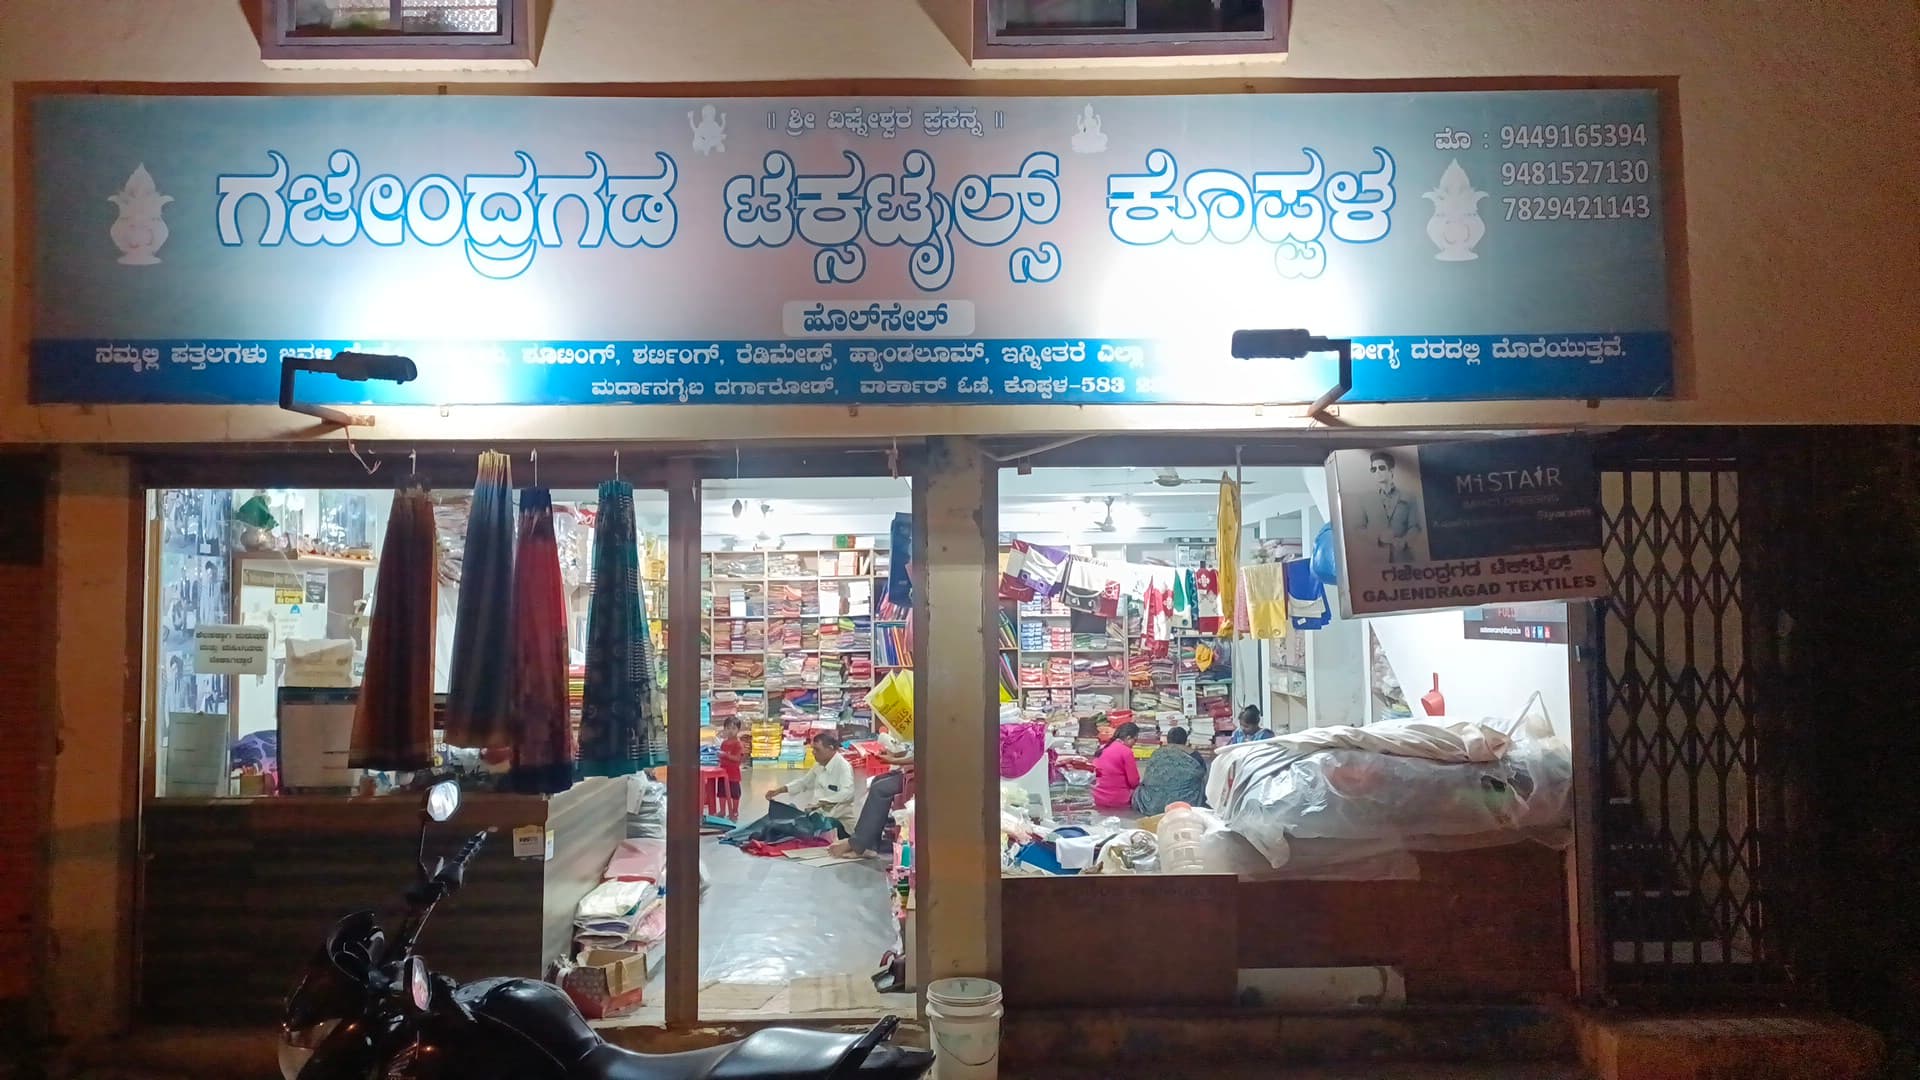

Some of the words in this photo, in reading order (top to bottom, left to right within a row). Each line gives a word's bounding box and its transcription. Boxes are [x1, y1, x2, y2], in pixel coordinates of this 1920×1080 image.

[786, 108, 816, 136] ಶ್ರೀ
[923, 106, 985, 137] ಪ್ರಸನ್ನ
[1500, 123, 1648, 150] 9449165394
[1501, 159, 1650, 186] 9481527130
[216, 149, 678, 280] ಗಜೇಂದ್ರಗಡ
[1106, 147, 1397, 279] ಕೊಪ್ಪಳ
[1502, 195, 1651, 221] 7829421143
[95, 343, 160, 373] ನಮ್ಮಲ್ಲಿ
[1411, 338, 1480, 366] ದರದಲ್ಲಿ
[1362, 581, 1500, 603] GAJENDRAGAD
[1506, 575, 1597, 595] TEXTILES
